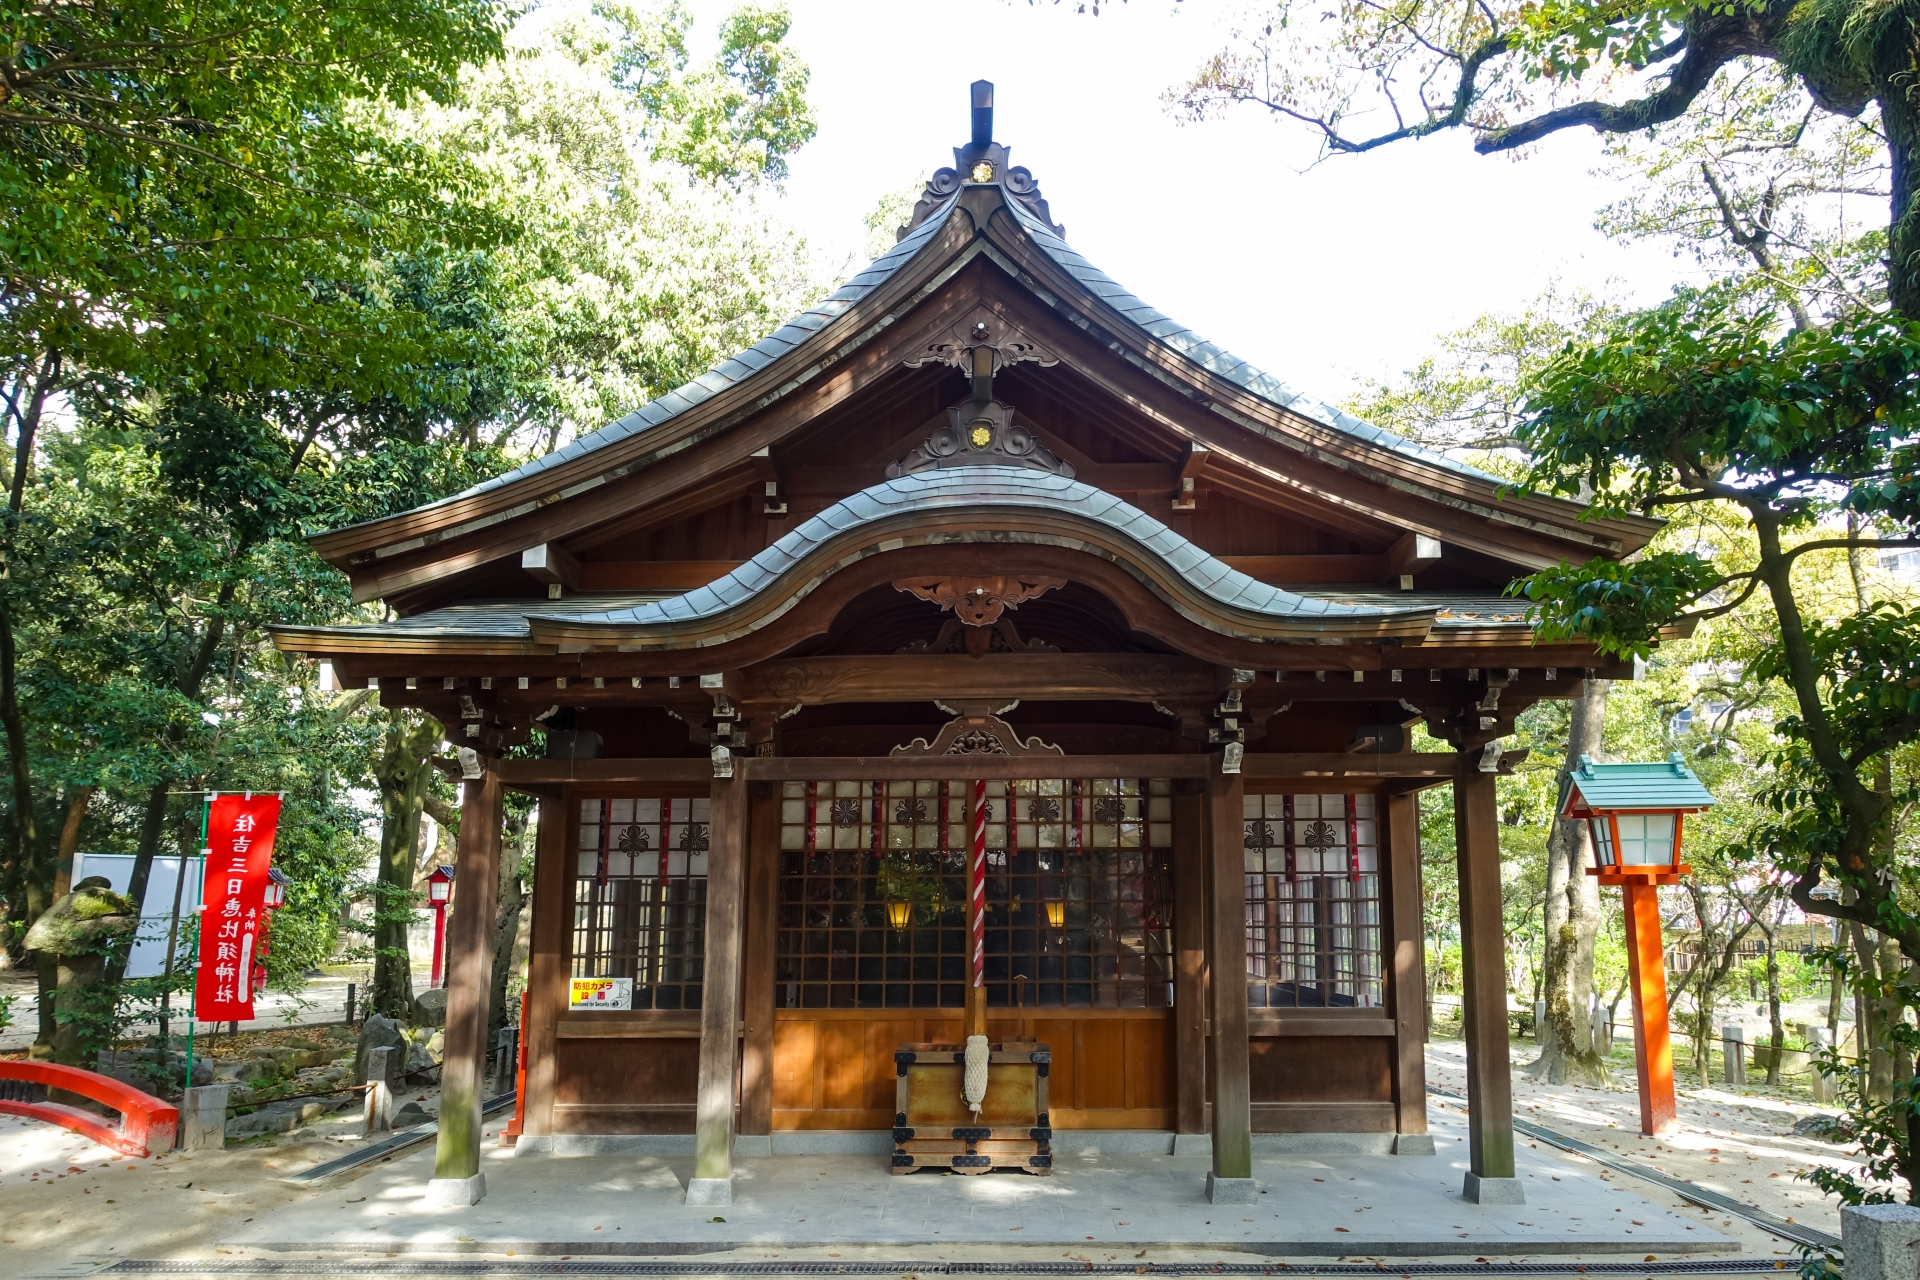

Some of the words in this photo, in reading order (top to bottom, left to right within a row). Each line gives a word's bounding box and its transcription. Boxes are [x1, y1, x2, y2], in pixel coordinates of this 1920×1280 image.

[574, 982, 613, 990] 防犯カメラ
